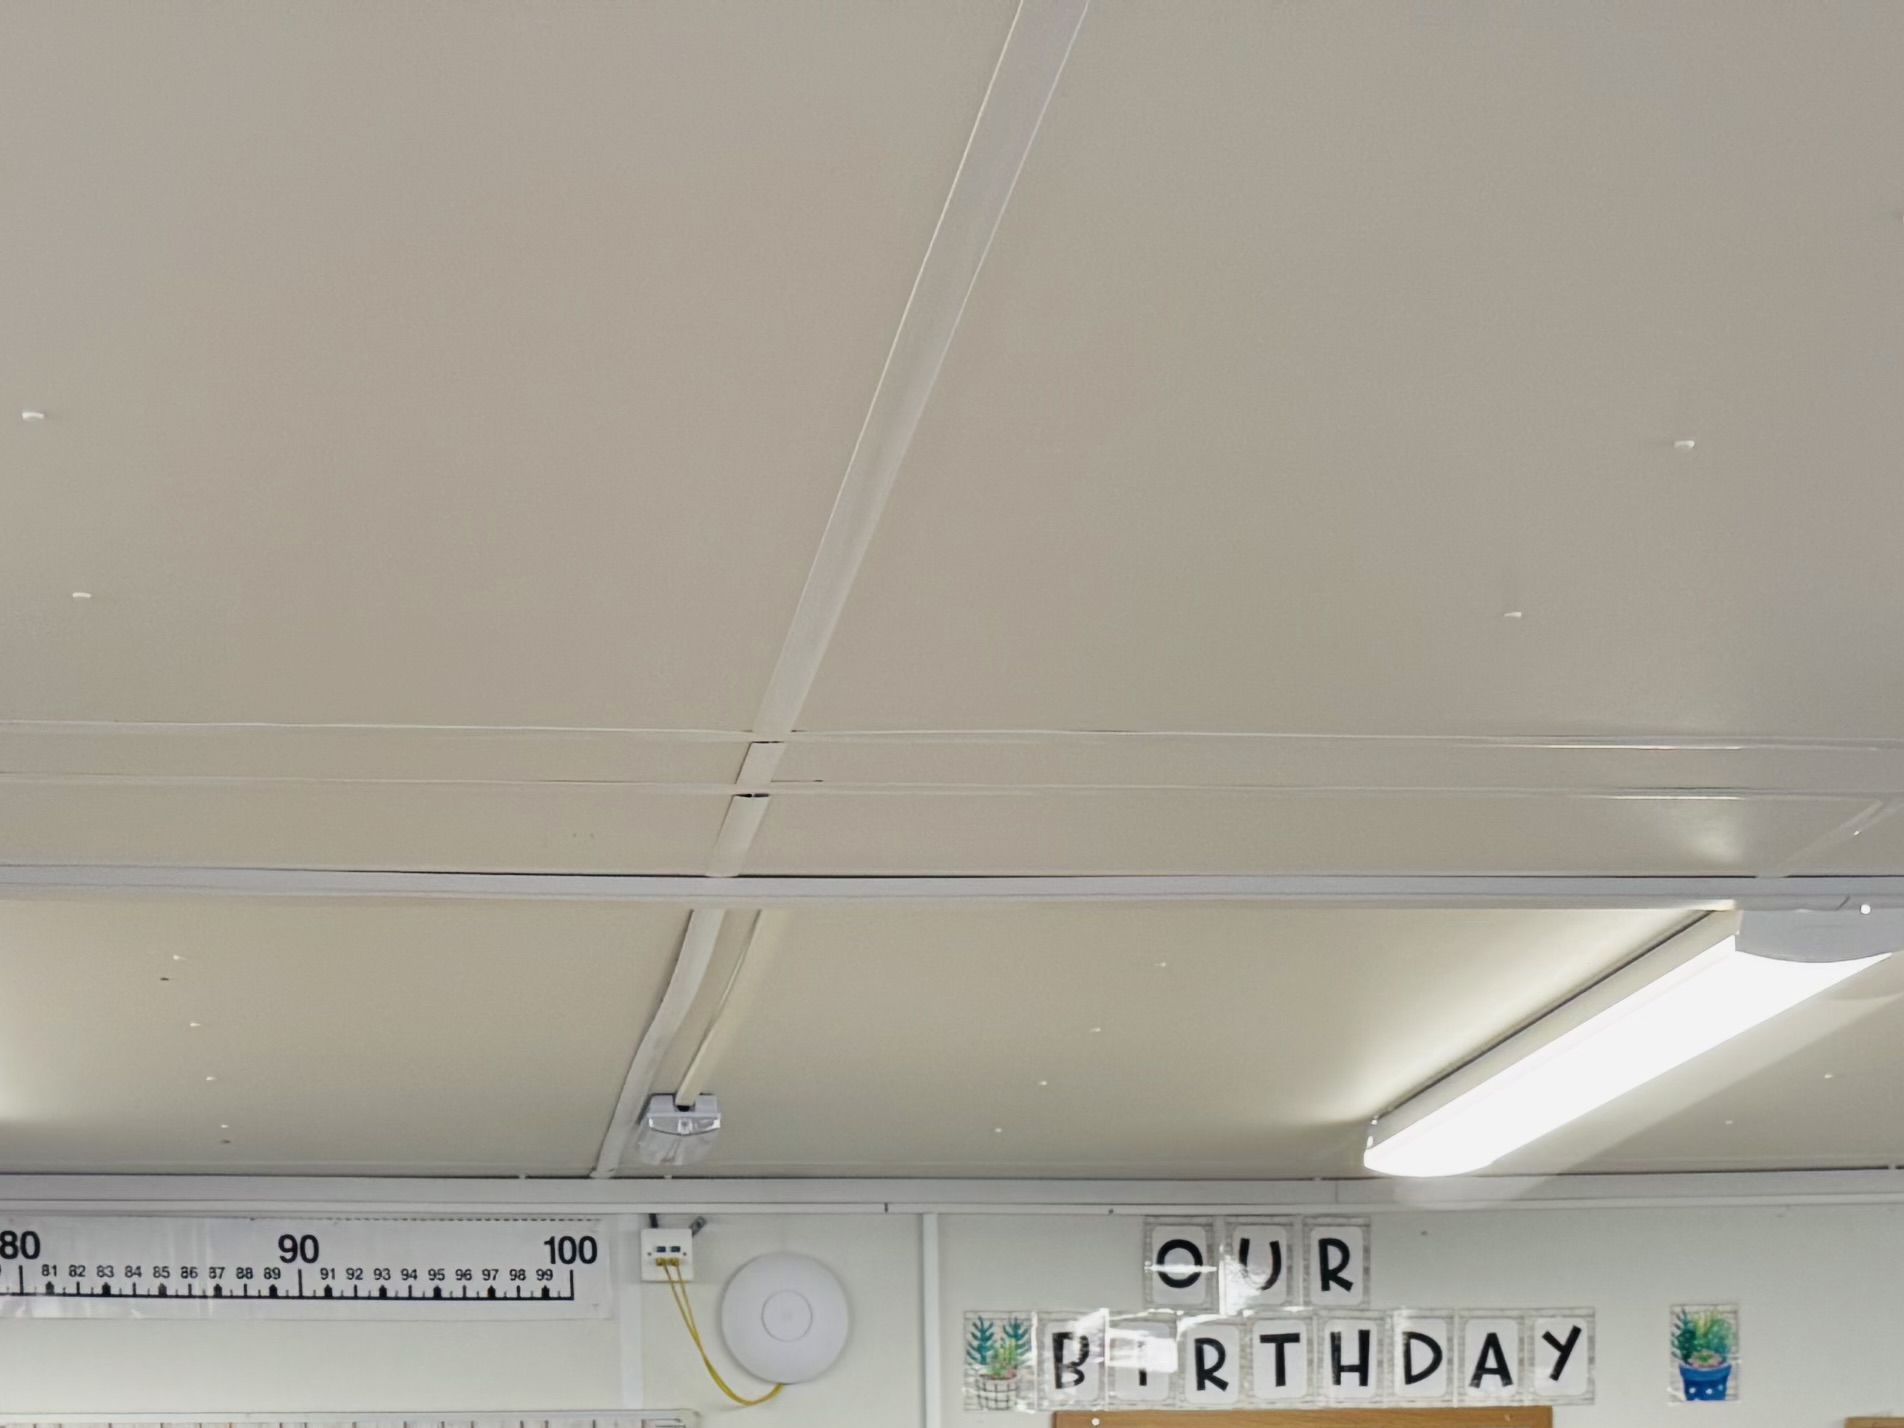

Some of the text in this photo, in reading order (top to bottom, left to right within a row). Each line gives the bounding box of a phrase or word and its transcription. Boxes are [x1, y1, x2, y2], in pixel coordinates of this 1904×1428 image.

[0, 1231, 40, 1259] 80
[279, 1234, 319, 1263] 90
[544, 1236, 597, 1264] 100
[41, 1263, 58, 1277] 81
[68, 1264, 86, 1278] 82
[96, 1264, 115, 1279] 83
[124, 1264, 143, 1279] 84
[152, 1265, 171, 1279] 85
[180, 1265, 199, 1280] 86
[208, 1266, 226, 1280] 87
[235, 1266, 254, 1280] 88
[263, 1266, 282, 1280] 89
[319, 1267, 336, 1281] 91
[345, 1267, 364, 1281] 92
[373, 1267, 392, 1281] 93
[400, 1268, 418, 1281] 94
[427, 1268, 446, 1282] 95
[455, 1268, 473, 1282] 96
[481, 1268, 500, 1282] 97
[509, 1268, 527, 1282] 98
[535, 1268, 554, 1282] 99
[1156, 1237, 1354, 1292] OUR
